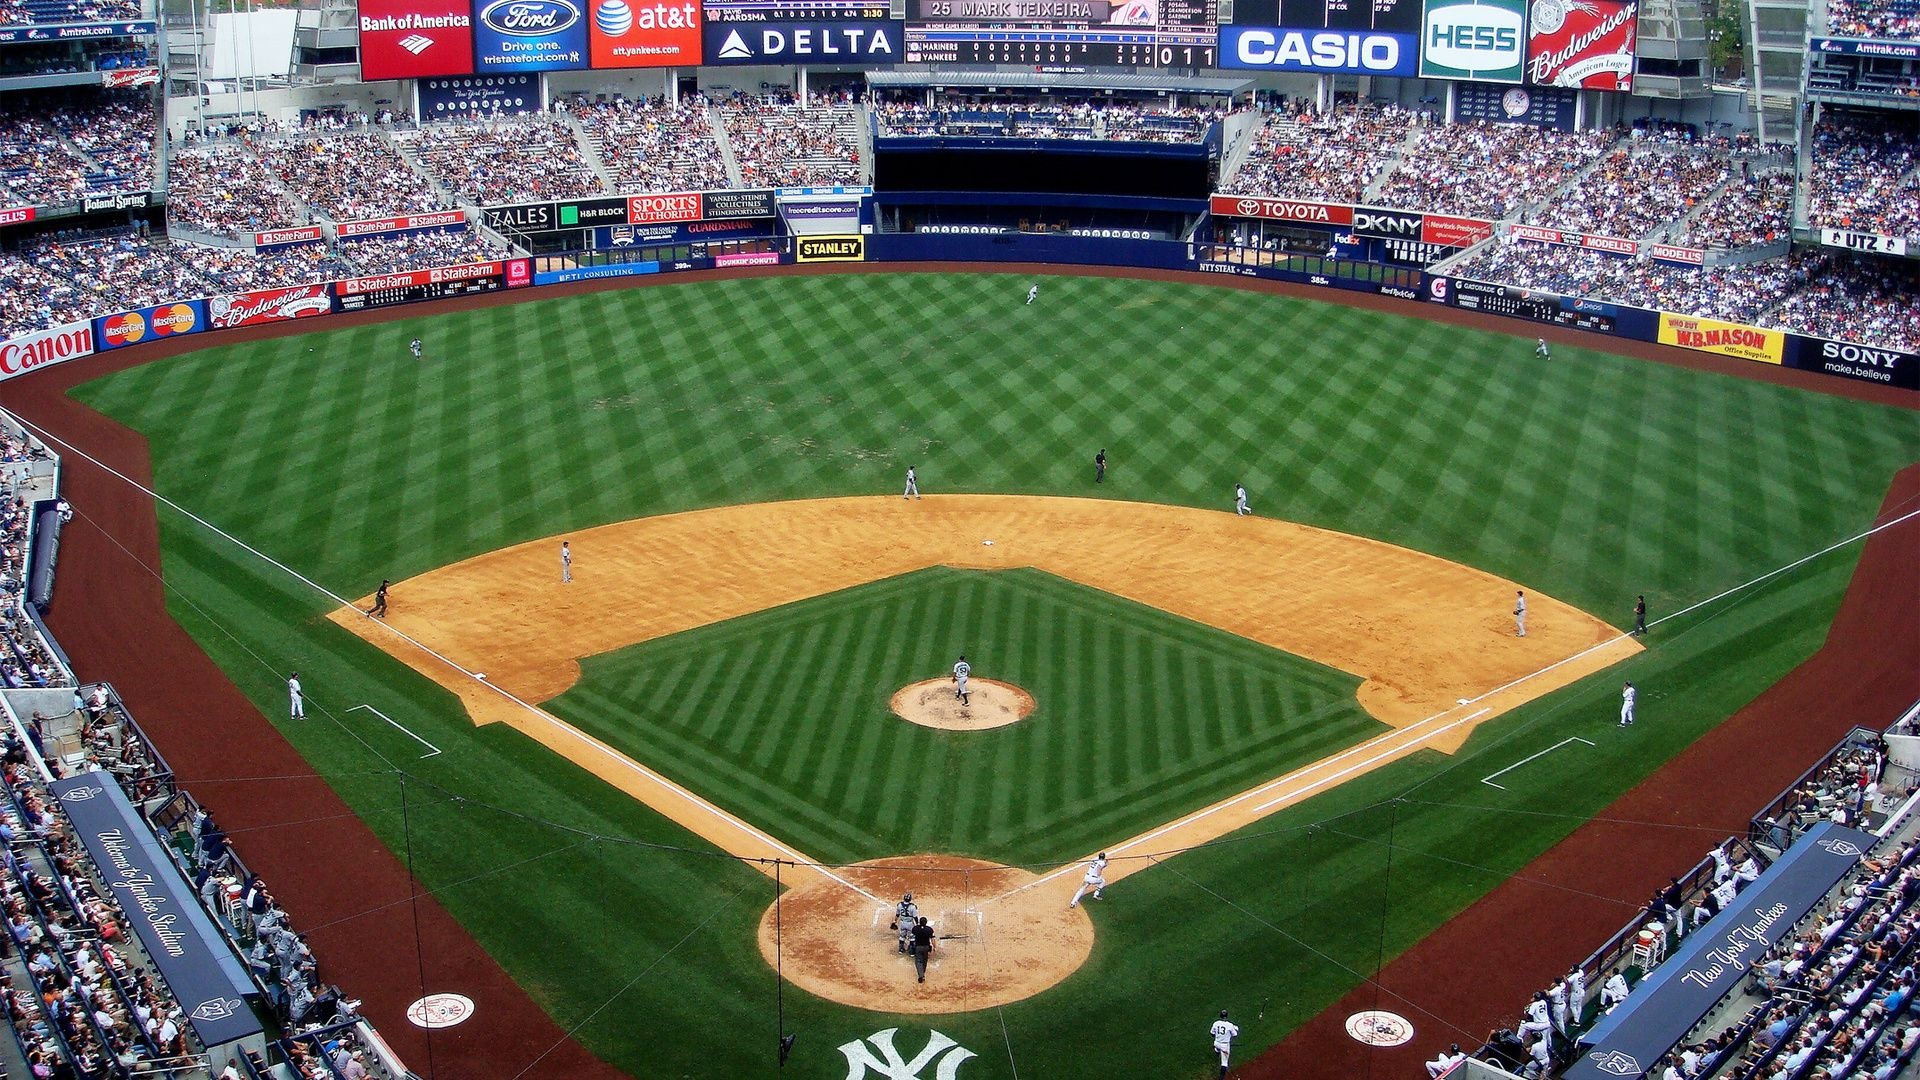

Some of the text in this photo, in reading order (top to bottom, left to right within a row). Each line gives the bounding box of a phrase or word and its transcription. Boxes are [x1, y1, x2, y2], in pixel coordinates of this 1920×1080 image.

[504, 2, 558, 28] Ford
[638, 3, 696, 29] at&t
[863, 9, 882, 17] 3:30
[932, 3, 1092, 17] 25 MARK TEIXEIRA
[361, 12, 470, 31] Bank of America
[59, 27, 113, 37] Amtrak.com
[1432, 24, 1515, 51] HESS
[502, 41, 561, 52] Drive one.
[763, 30, 892, 54] DELTA
[1065, 44, 1070, 52] 0
[1145, 46, 1150, 54] 0
[1528, 2, 1636, 84] Budweiser
[1856, 43, 1916, 56] Amtrak.com
[612, 44, 680, 56] att.yankees.com
[923, 53, 957, 61] YANKEES
[1161, 48, 1212, 65] 0 1 1
[1238, 31, 1399, 70] CASIO
[484, 52, 569, 64] tristateford.com
[1567, 58, 1630, 84] American Lager
[84, 194, 147, 213] Poland Spring
[632, 196, 697, 213] SPORTS
[716, 200, 762, 208] COLLECTIBLES
[788, 206, 856, 214] freecreditscore.com
[491, 208, 548, 227] ZALES
[580, 208, 624, 218] H&R BLOCK
[1263, 202, 1329, 221] TOYOTA
[688, 221, 753, 233] GUARDSMARK
[1354, 214, 1422, 235] DKNY
[1335, 233, 1360, 246] FedEx
[1385, 240, 1441, 254] SHARPER
[1587, 238, 1632, 251] MODELL'S
[1846, 233, 1877, 250] UTZ
[804, 243, 858, 255] STANLEY
[1394, 250, 1432, 262] IMAGE
[1653, 247, 1701, 261] MODELL'S
[584, 268, 634, 279] CONSULTING
[1200, 263, 1214, 272] NYY
[1214, 264, 1236, 273] STEAK
[1431, 278, 1446, 297] G
[1464, 284, 1495, 293] GATORADE
[222, 286, 310, 327] Budweiser
[1584, 303, 1602, 311] pepsi
[153, 312, 195, 329] MasterCard
[105, 321, 146, 337] MasterCard
[1676, 329, 1766, 349] W.B.MASON
[0, 327, 92, 374] Canon
[1724, 346, 1772, 360] Office Supplies
[1823, 342, 1900, 368] SONY
[1825, 362, 1891, 381] make.believe
[97, 828, 186, 957] Welcome to Yankee Stadium
[1681, 902, 1788, 988] New York Yankees
[1217, 1026, 1226, 1035] 13
